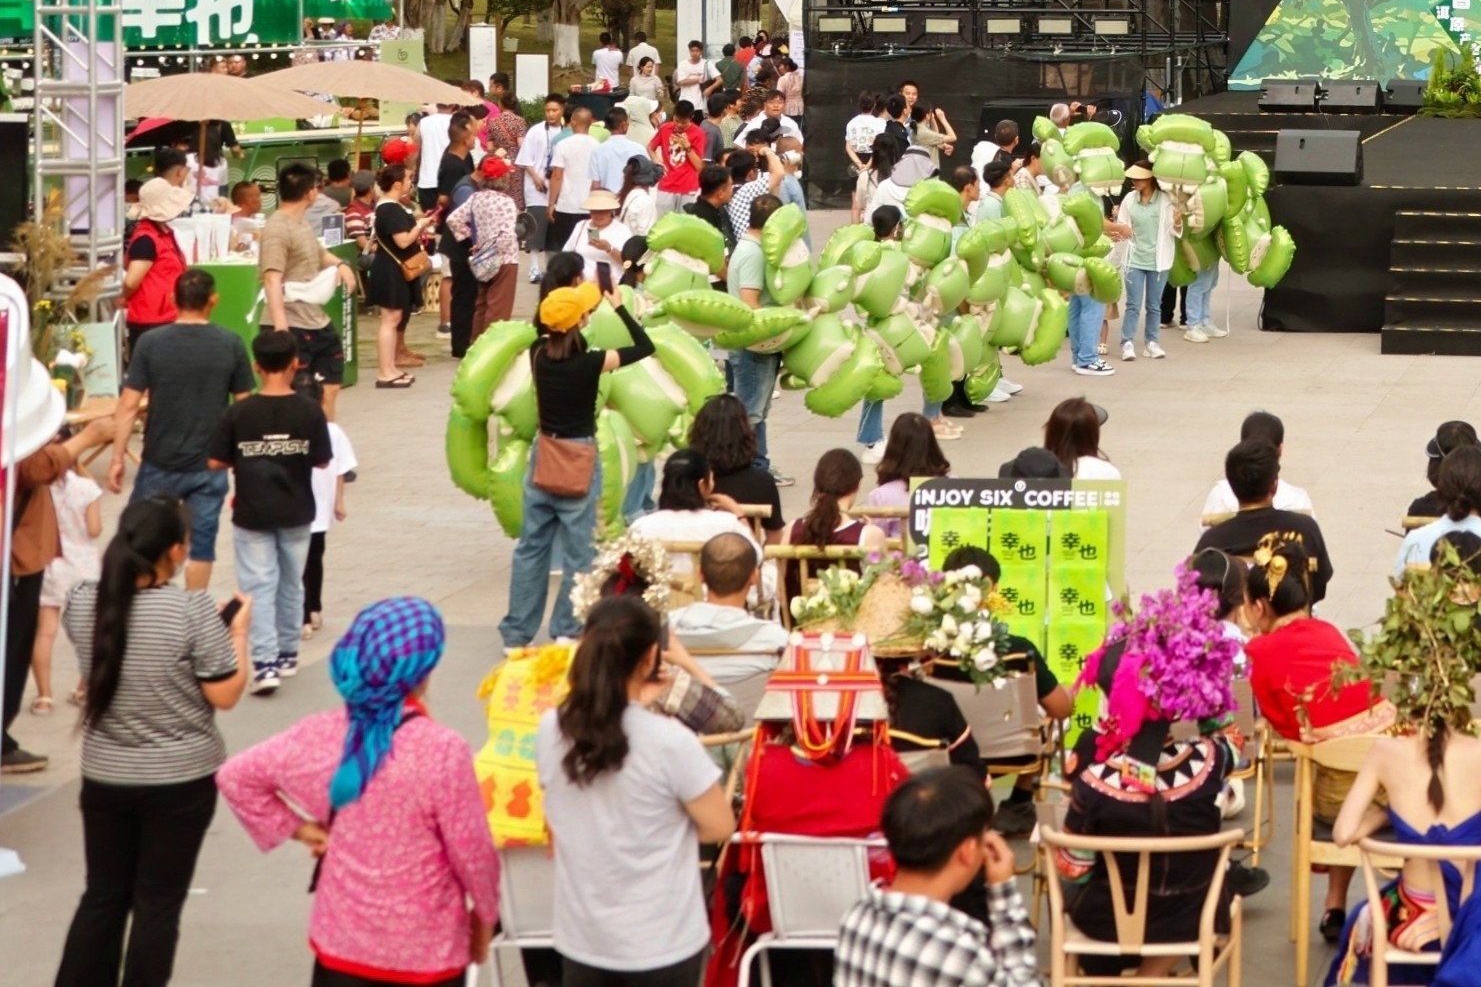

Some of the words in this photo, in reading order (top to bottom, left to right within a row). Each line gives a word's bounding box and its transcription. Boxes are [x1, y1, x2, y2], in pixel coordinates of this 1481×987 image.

[979, 489, 1013, 506] SIX
[1023, 490, 1098, 507] COFFEE
[1001, 532, 1037, 561] 幸也
[1061, 532, 1098, 561] 幸也
[1059, 587, 1097, 616] 幸也
